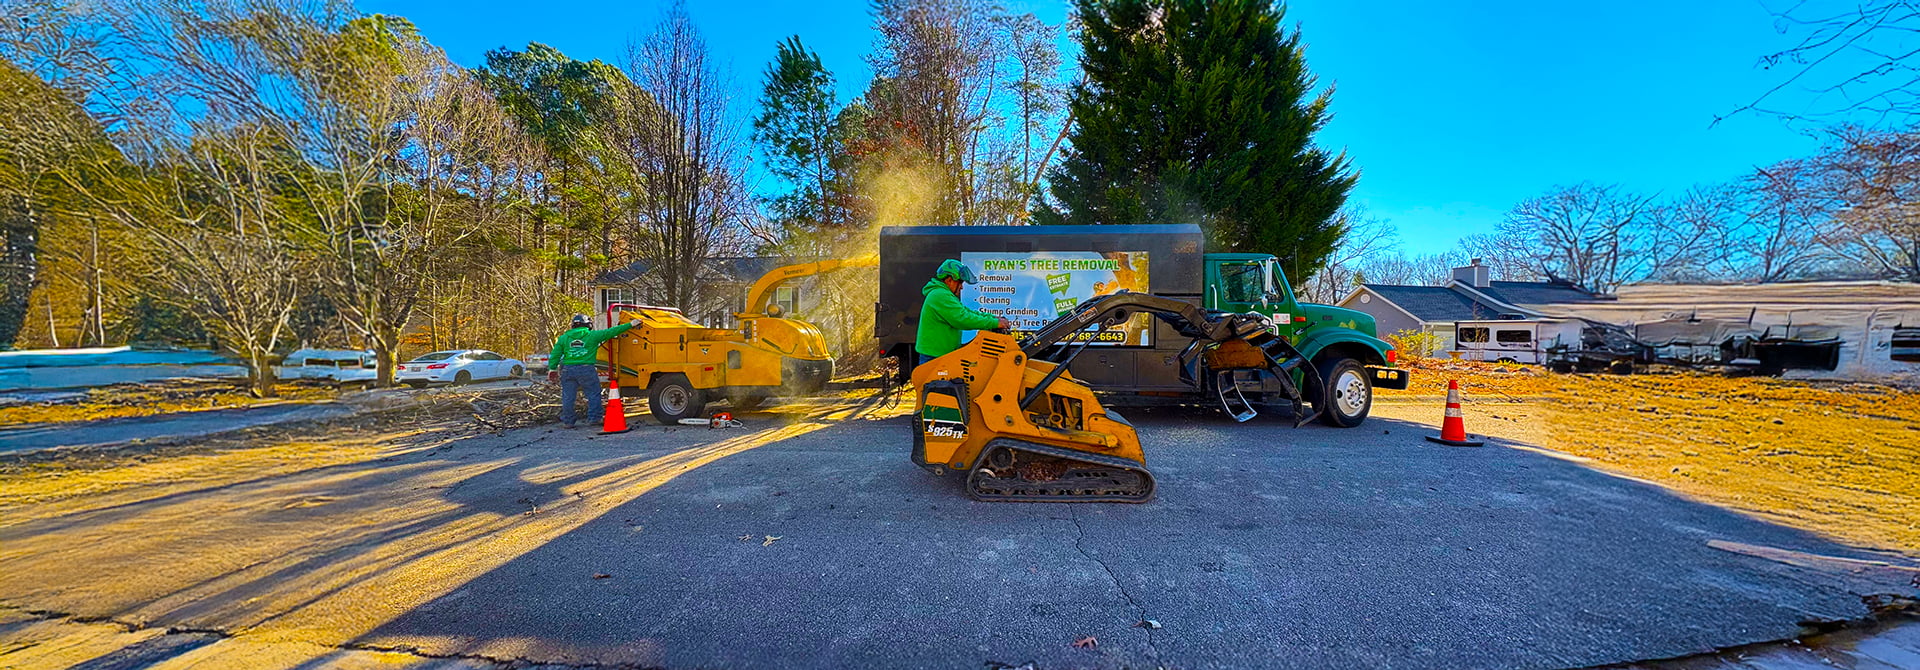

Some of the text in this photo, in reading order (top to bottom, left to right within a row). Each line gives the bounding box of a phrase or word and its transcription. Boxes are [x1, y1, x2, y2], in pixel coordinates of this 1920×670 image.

[984, 259, 1120, 270] RYAN'S TREE REMOVAL
[979, 273, 1012, 281] Removal
[1048, 275, 1067, 286] FREE
[979, 285, 1016, 294] Trimming
[979, 296, 1011, 305] Clearing
[1005, 307, 1038, 317] Grinding
[1023, 319, 1041, 327] Tree
